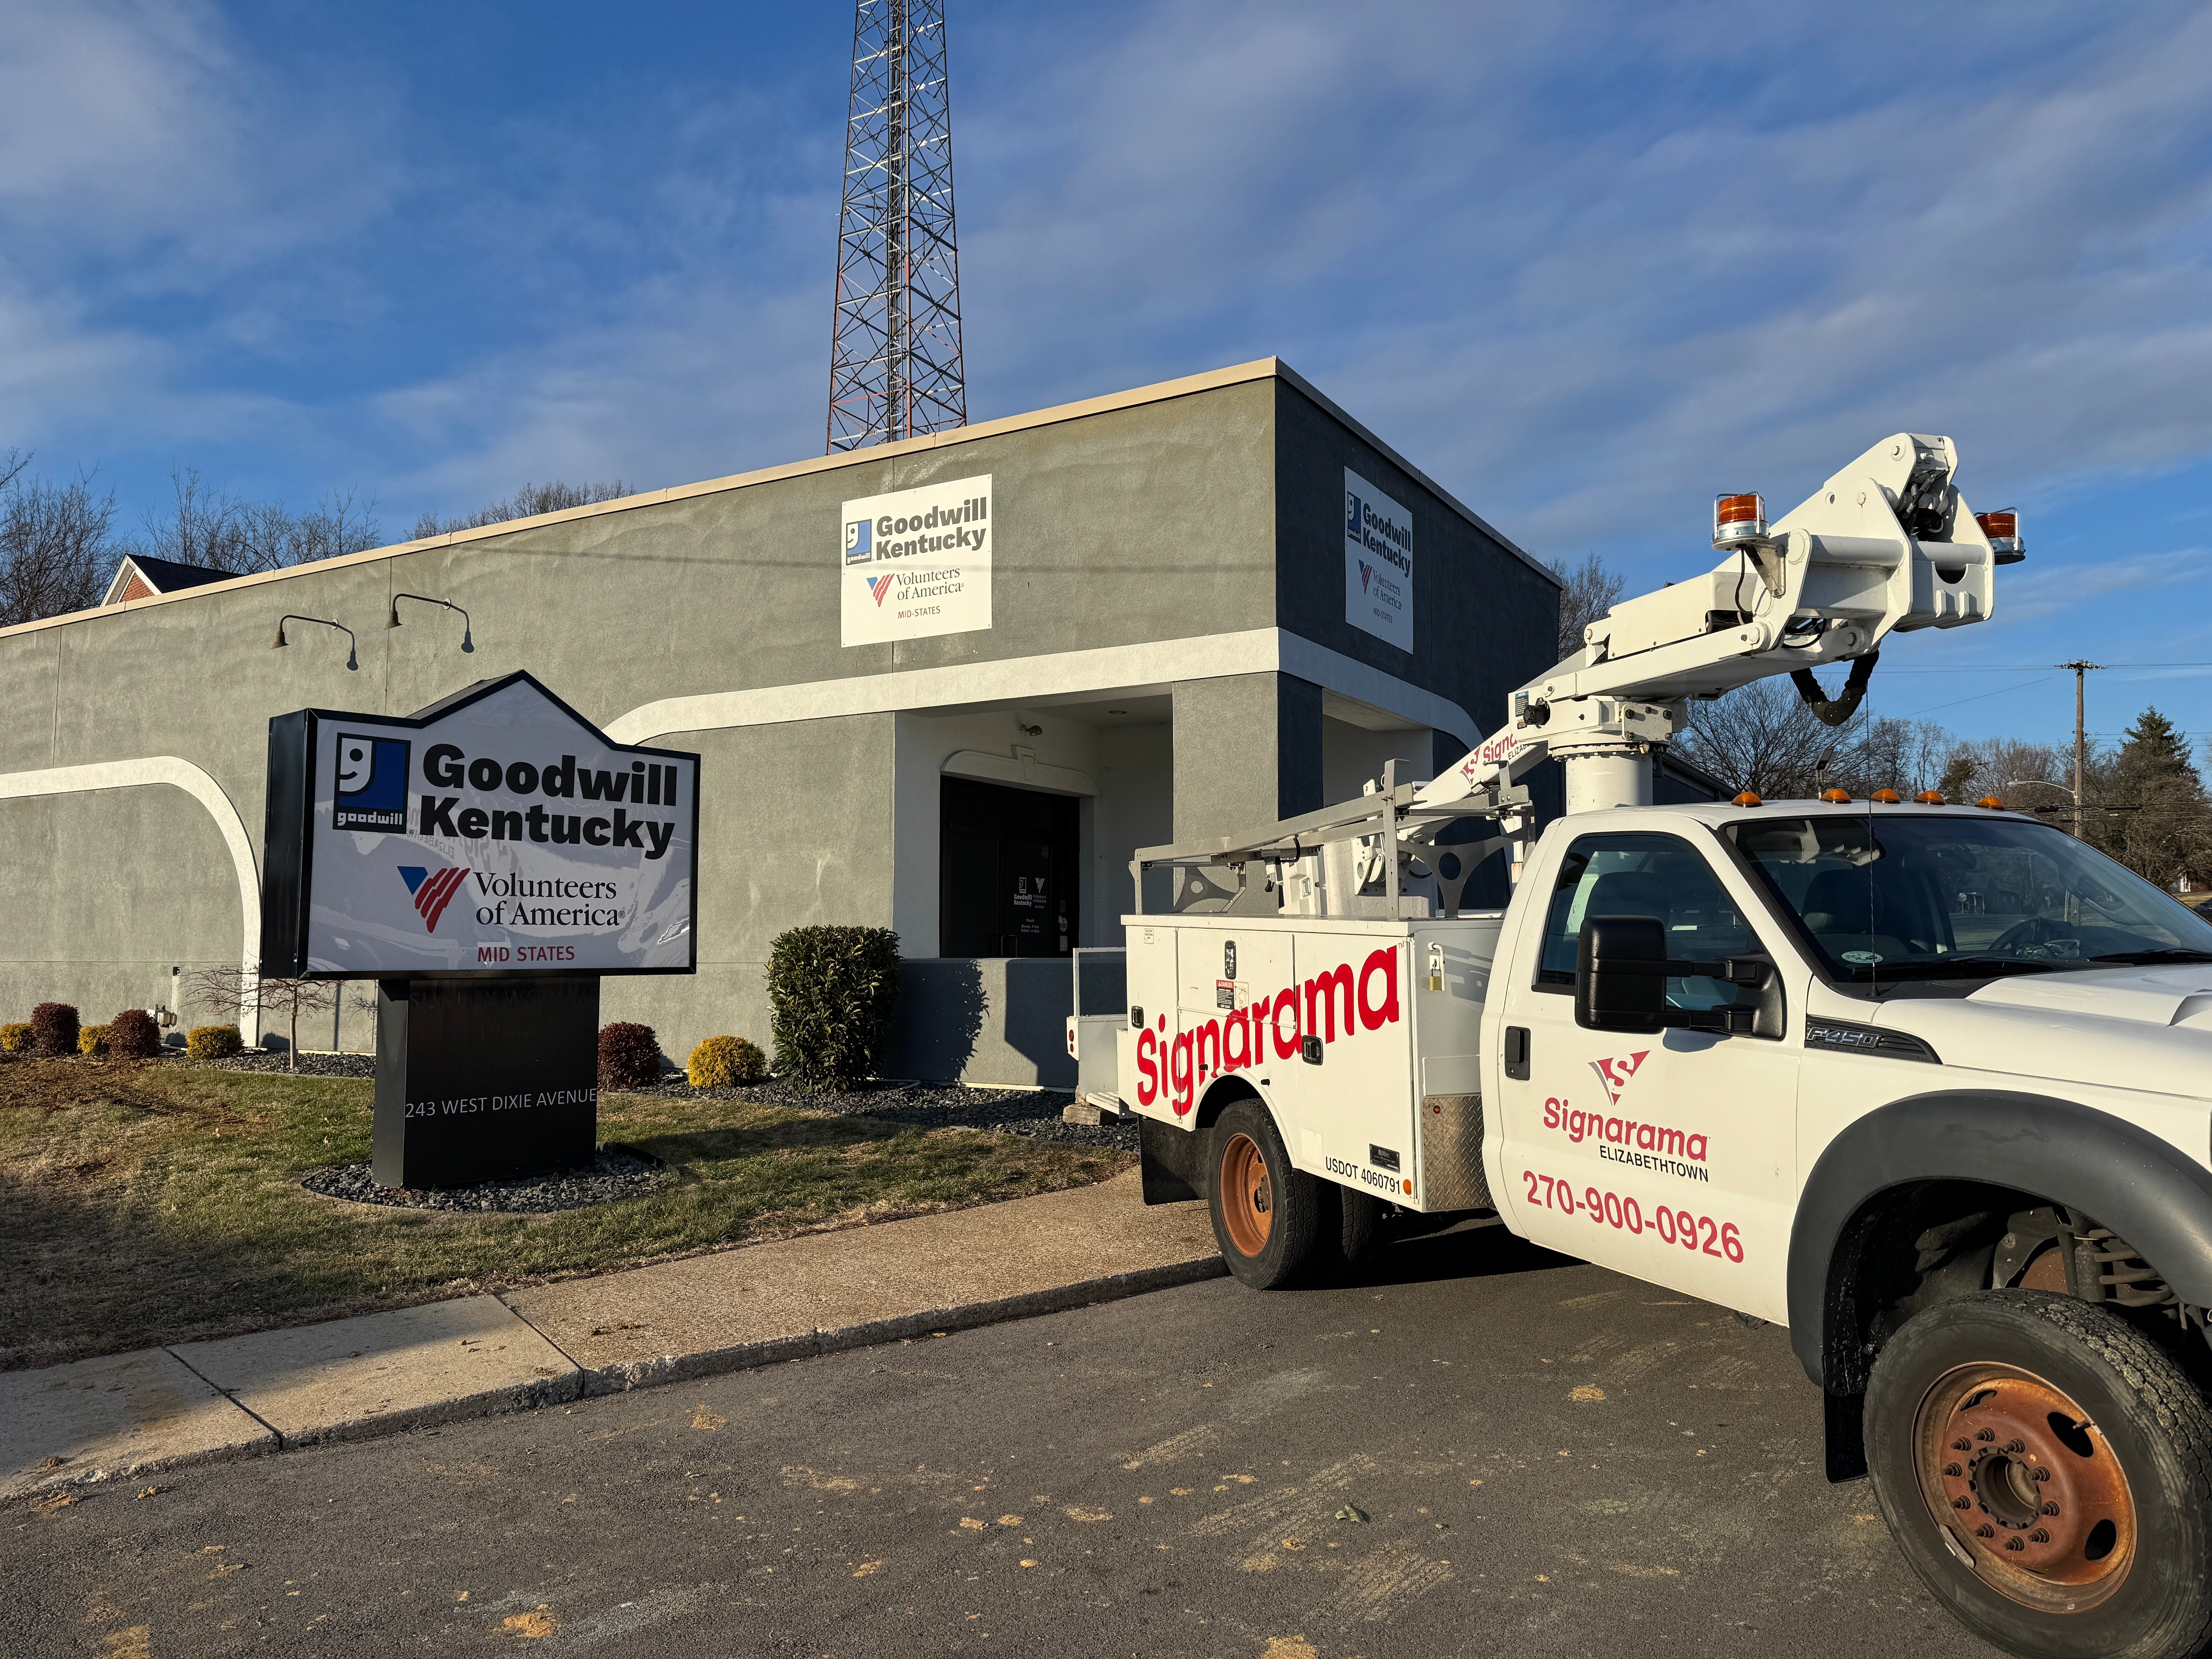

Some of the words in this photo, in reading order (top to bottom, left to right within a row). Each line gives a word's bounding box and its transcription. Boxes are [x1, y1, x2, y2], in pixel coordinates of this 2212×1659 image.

[876, 496, 987, 538] Goodwill
[1363, 503, 1411, 553] Goodwill
[876, 527, 986, 561] Kentucky
[1363, 527, 1411, 578] Kentucky
[896, 568, 960, 586] Volunteers
[897, 586, 910, 601] of
[1372, 569, 1401, 596] Volunteers
[1373, 586, 1379, 599] of
[898, 606, 941, 619] MID-STATES
[422, 744, 677, 806] Goodwill
[337, 811, 403, 826] goodwill
[419, 795, 675, 860] Kentucky
[473, 871, 616, 900] Volunteers
[476, 902, 503, 926] of
[477, 947, 510, 962] MID
[517, 946, 575, 962] STATES
[1137, 944, 1399, 1116] Signarama
[405, 1102, 435, 1118] 243
[441, 1097, 488, 1115] WEST
[492, 1093, 532, 1111] DIXIE
[536, 1088, 597, 1107] AVENUE
[1543, 1097, 1707, 1162] Signarama
[1325, 1156, 1358, 1180] USDOT
[1360, 1170, 1401, 1195] 4060791
[1599, 1145, 1709, 1183] ELIZABETHTOWN
[1522, 1170, 1744, 1264] 270-900-0926
